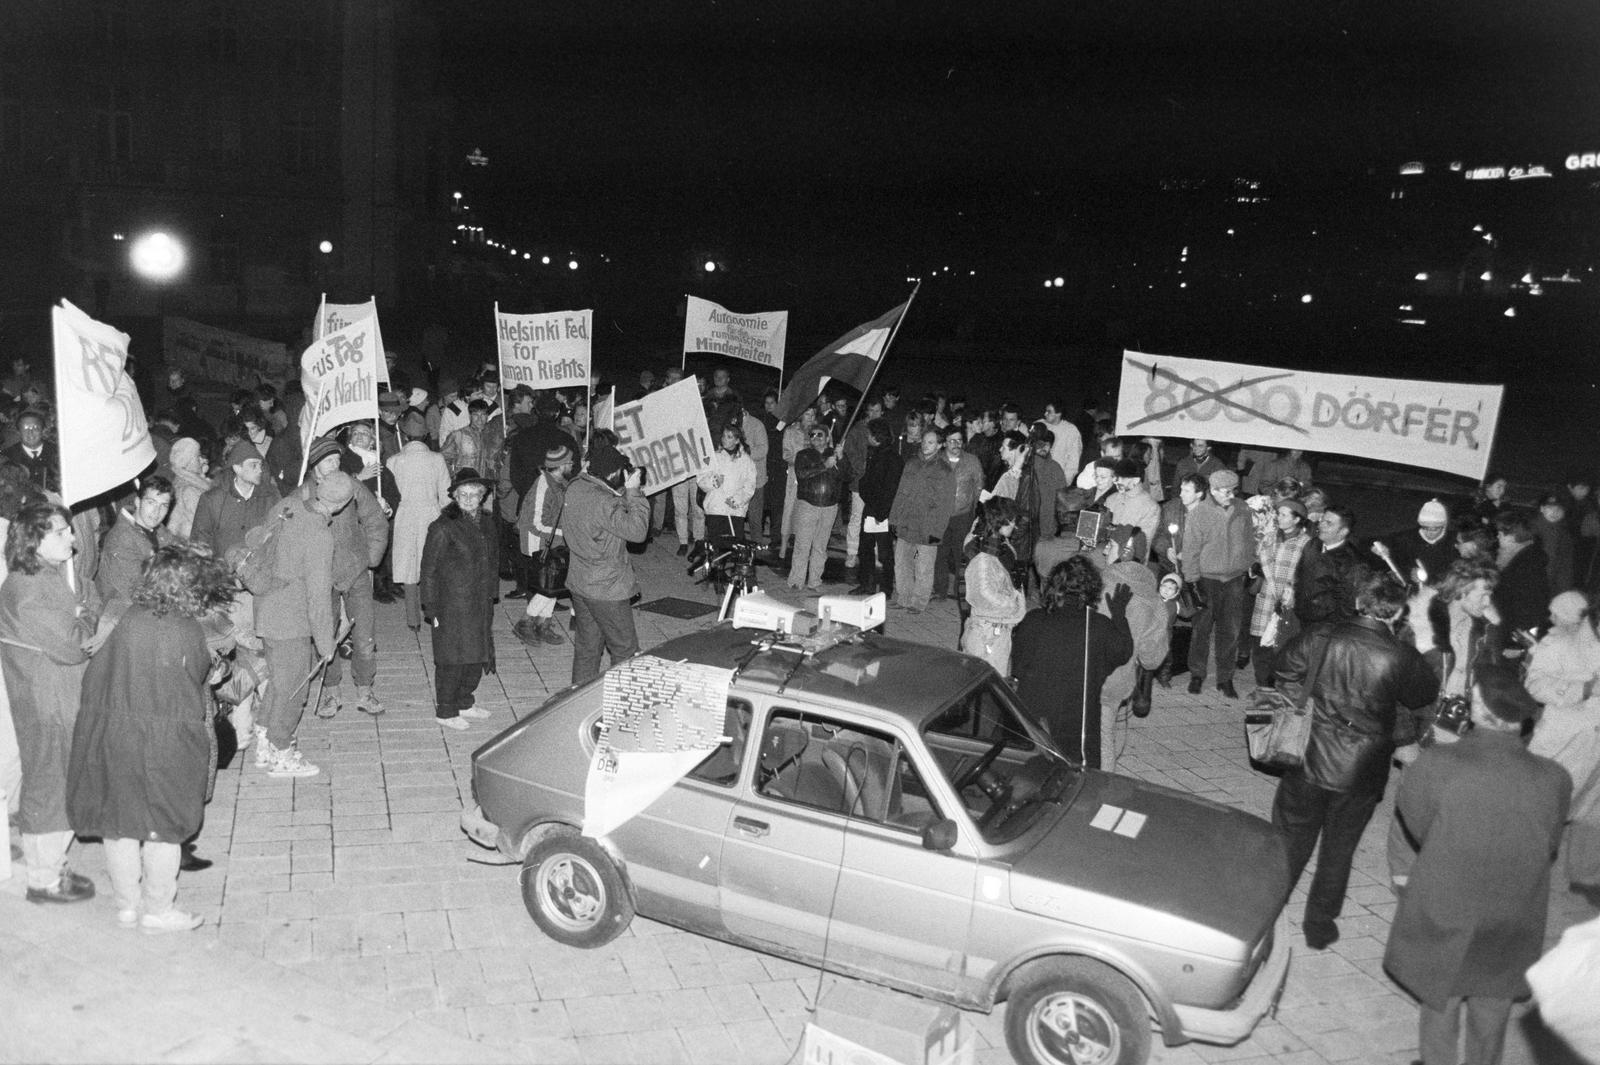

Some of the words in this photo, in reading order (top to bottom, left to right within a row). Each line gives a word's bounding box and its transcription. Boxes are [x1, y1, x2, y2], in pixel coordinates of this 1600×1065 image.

[500, 319, 560, 342] Helsinki
[565, 316, 589, 340] Fed.
[709, 309, 768, 330] Autonomie
[326, 332, 366, 367] Tag
[512, 342, 539, 360] for
[696, 337, 772, 363] Minderheiten
[538, 358, 585, 380] Rights
[335, 368, 371, 407] Nacht
[1144, 366, 1301, 424] 8.000
[1311, 390, 1481, 451] DÖRFER
[614, 405, 644, 446] ET
